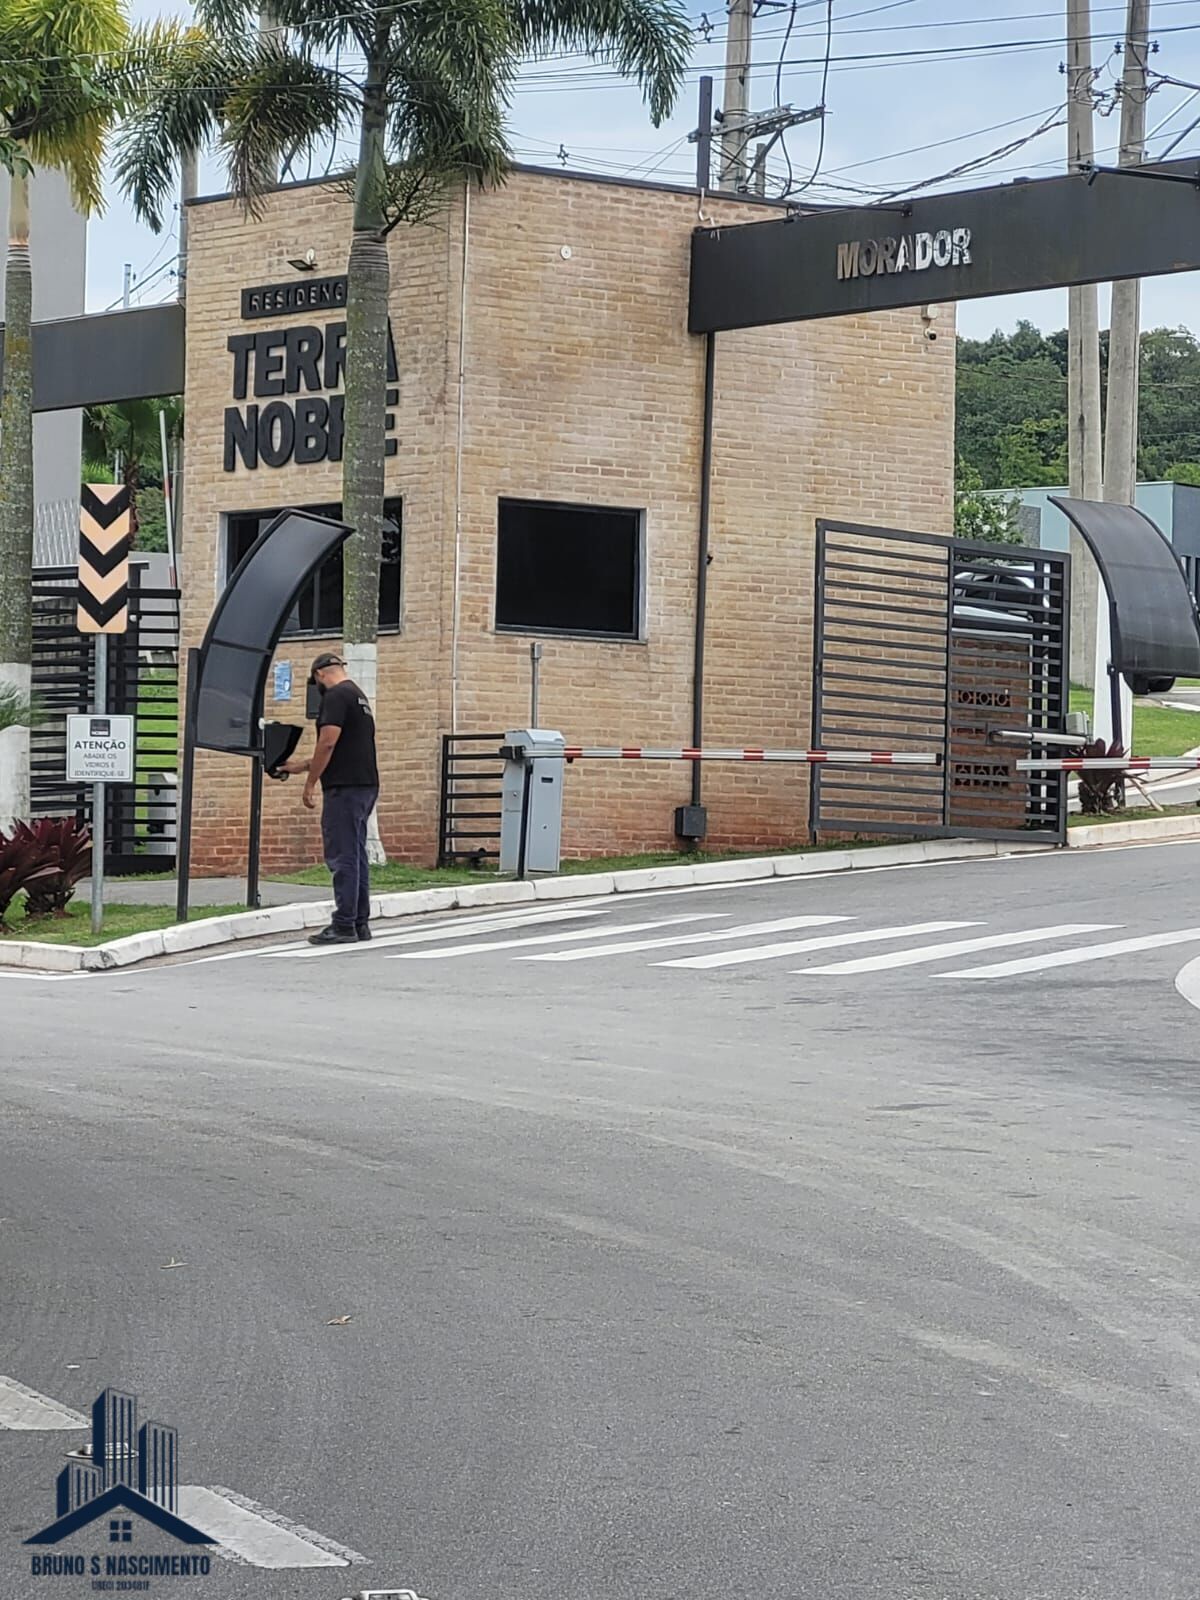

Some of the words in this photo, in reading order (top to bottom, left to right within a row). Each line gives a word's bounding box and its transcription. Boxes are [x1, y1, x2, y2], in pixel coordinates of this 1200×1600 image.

[837, 227, 973, 280] MORADOR
[250, 283, 344, 311] RESIDENC
[74, 739, 126, 751] ATENÇÃO
